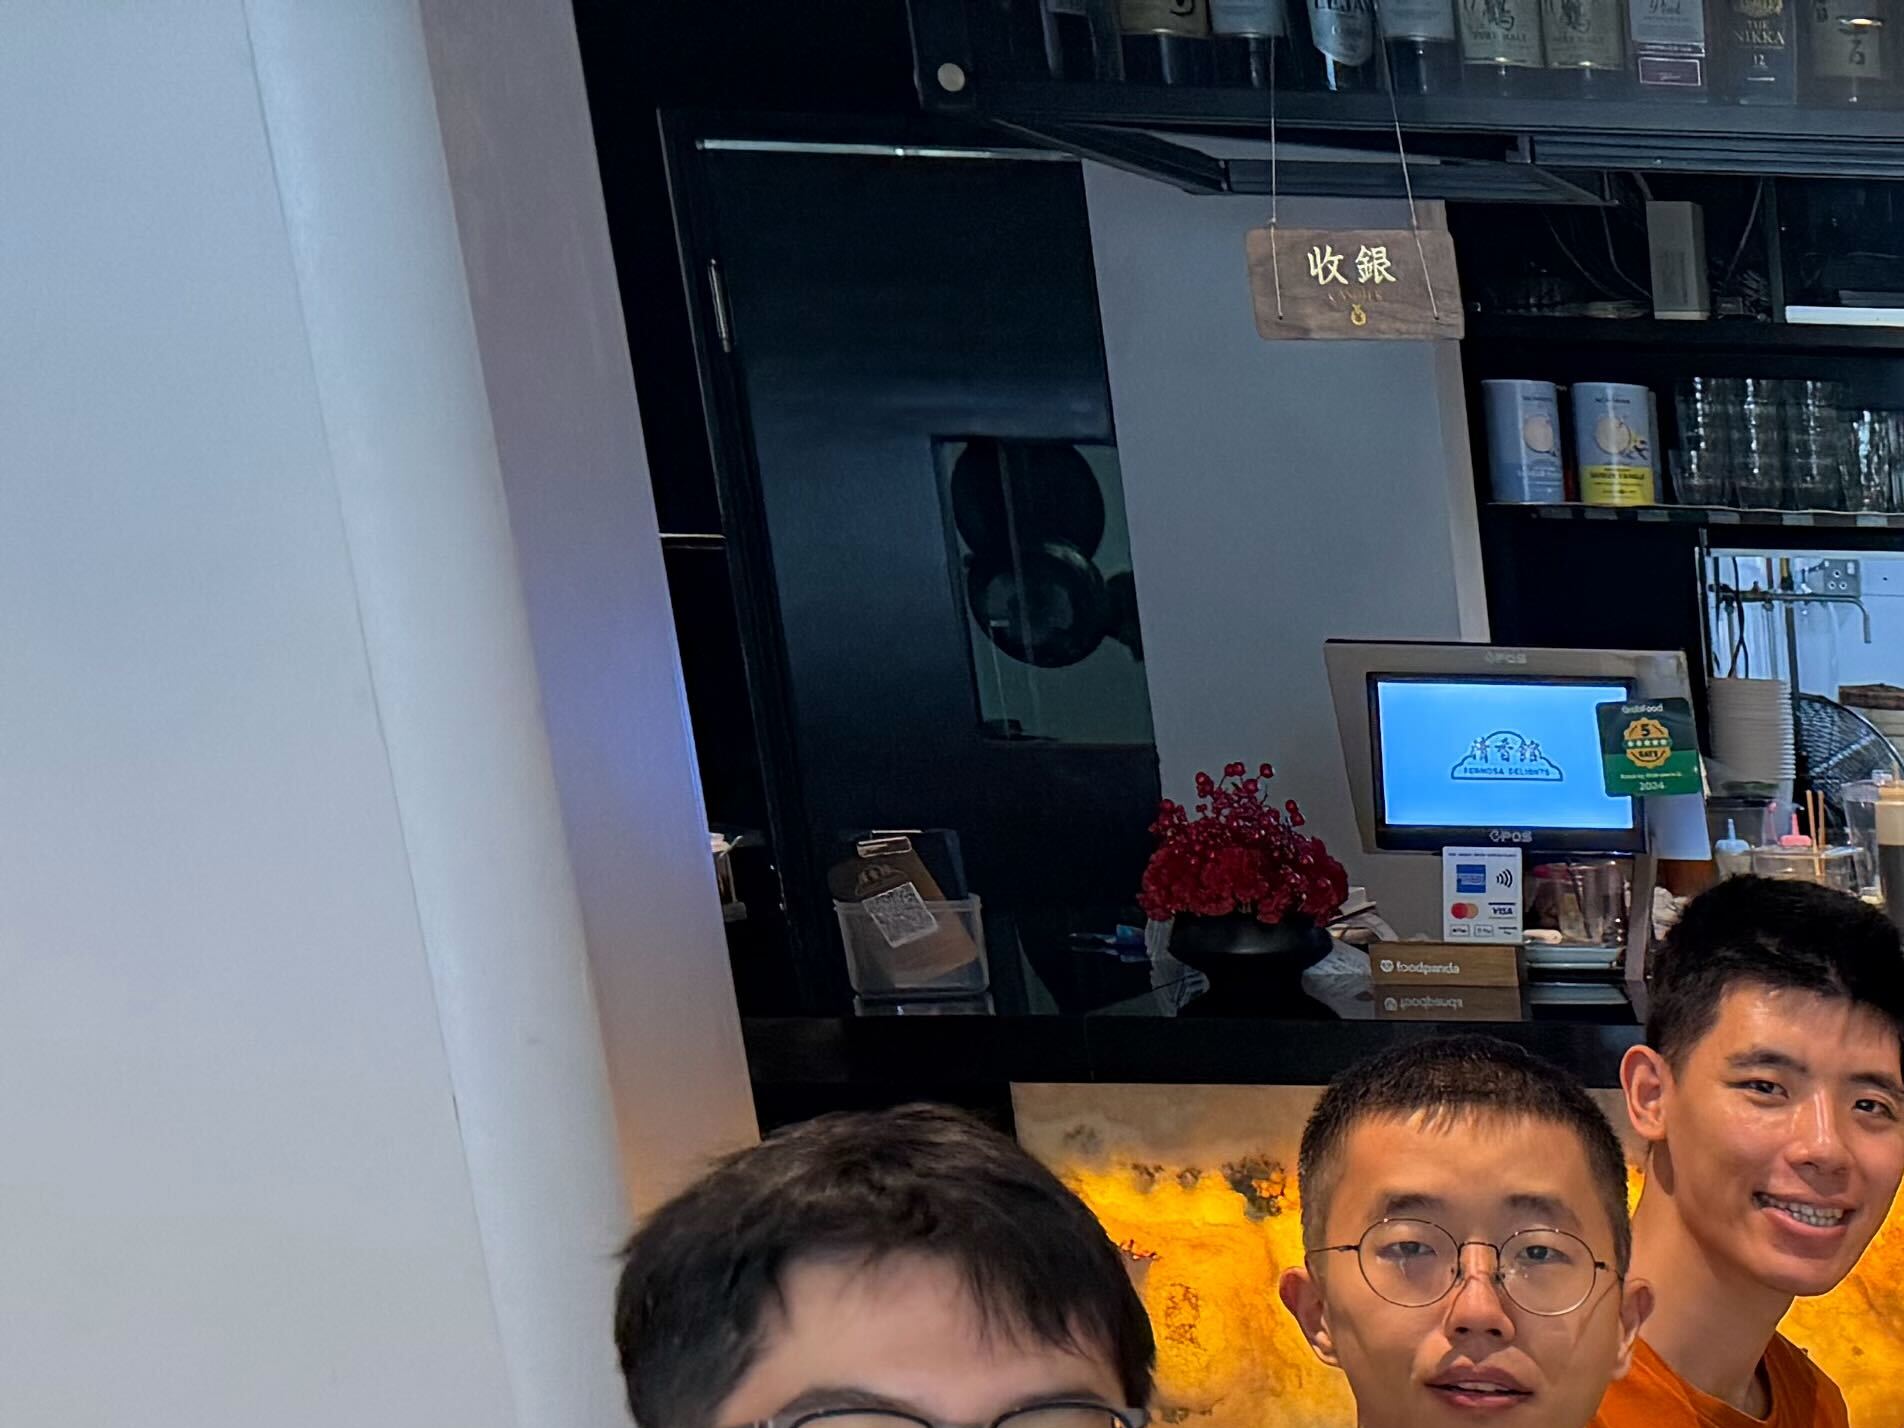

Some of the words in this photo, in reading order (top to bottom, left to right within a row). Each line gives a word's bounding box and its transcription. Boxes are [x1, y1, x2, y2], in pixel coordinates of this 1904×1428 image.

[1735, 29, 1785, 46] NIKKA
[1307, 244, 1397, 285] 收銀
[1640, 723, 1651, 737] 5
[1492, 906, 1514, 916] VISA
[1396, 959, 1461, 975] foodpanda
